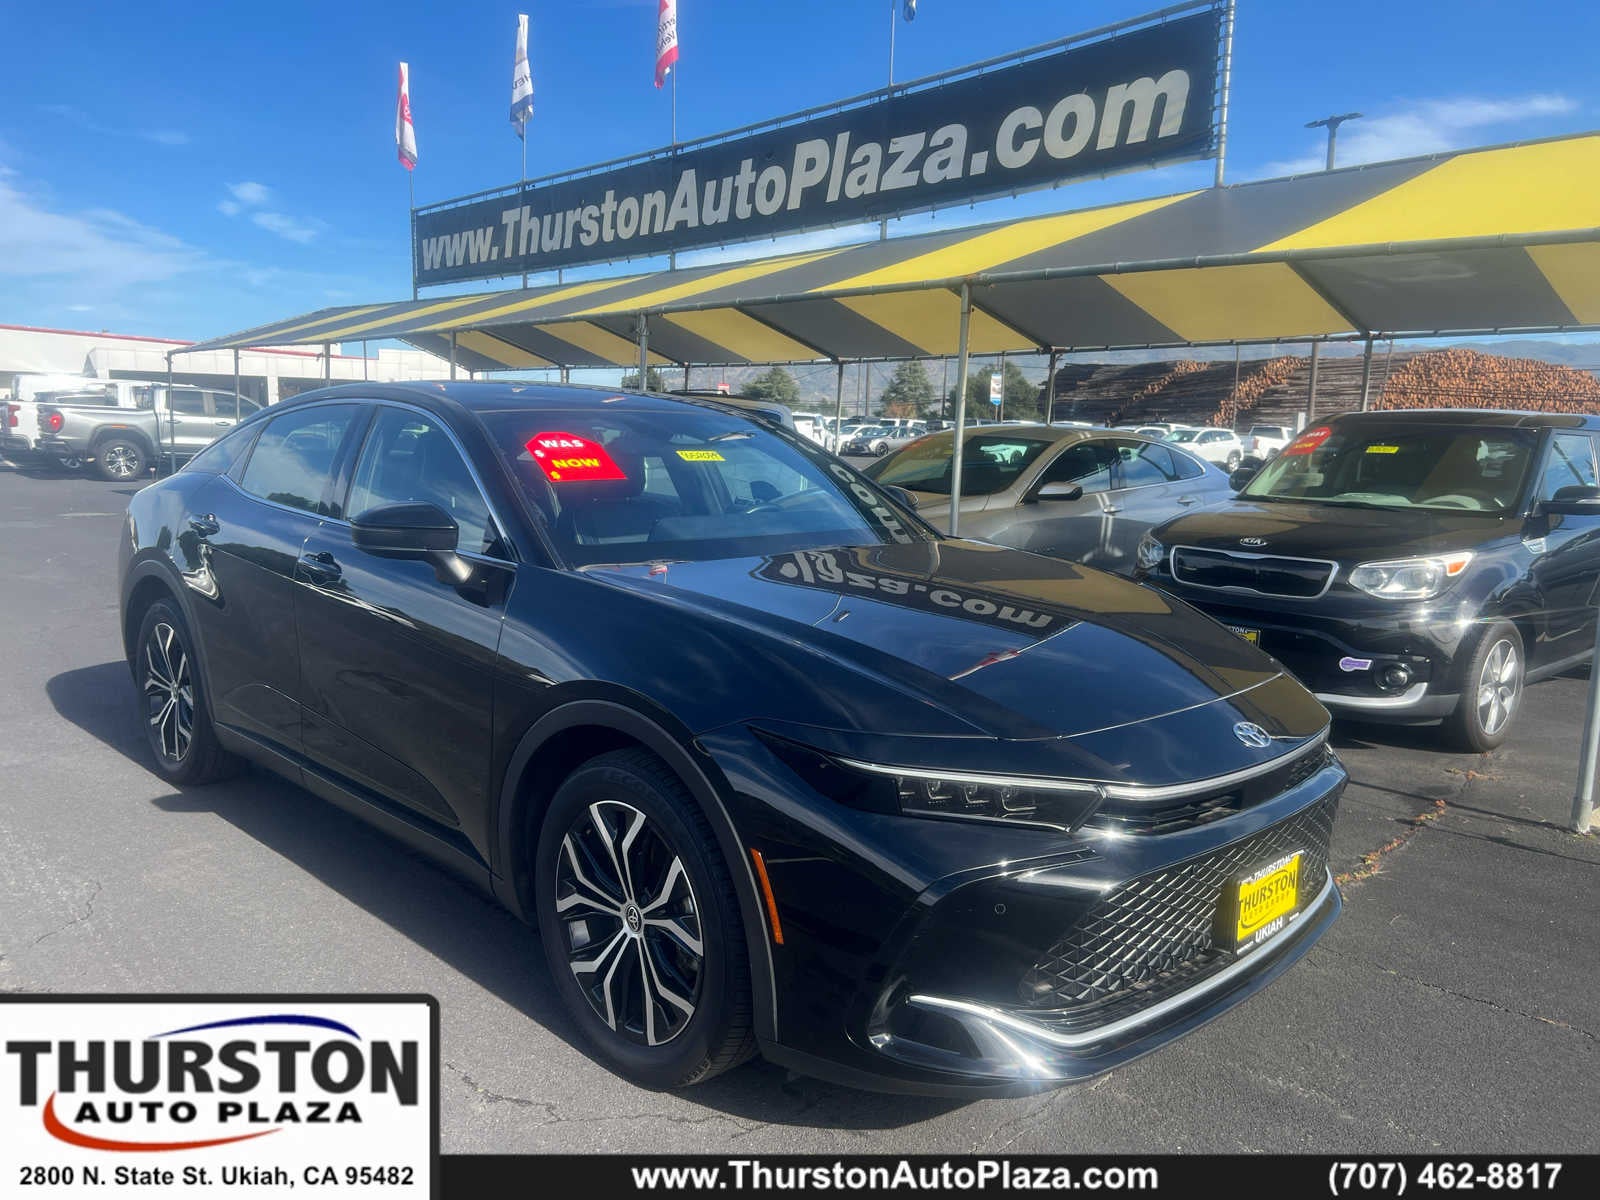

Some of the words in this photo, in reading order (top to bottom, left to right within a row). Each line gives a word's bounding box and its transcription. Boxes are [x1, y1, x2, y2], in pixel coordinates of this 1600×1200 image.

[422, 69, 1190, 271] www.ThurstonAutoPlaza.com
[540, 439, 584, 449] WAS
[552, 458, 600, 469] NOW
[1254, 855, 1291, 881] THURSTON
[1239, 871, 1297, 913] THURSTON
[1255, 917, 1283, 943] UKIAH
